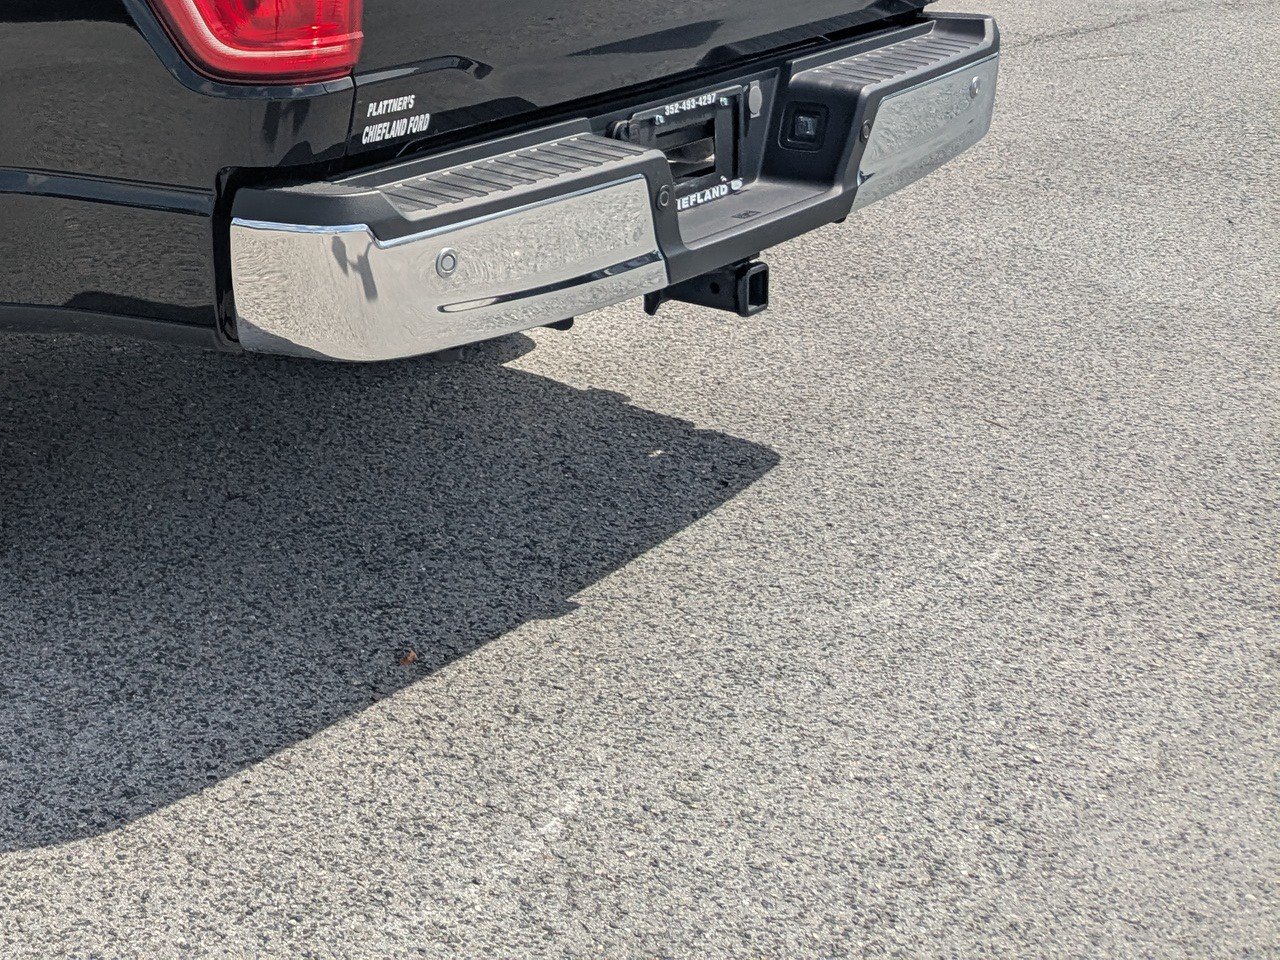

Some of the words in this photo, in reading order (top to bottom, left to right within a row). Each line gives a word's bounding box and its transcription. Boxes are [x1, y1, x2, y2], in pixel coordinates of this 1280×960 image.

[366, 95, 416, 118] PLATTNER'S
[361, 118, 408, 145] CHIEFLAND
[406, 113, 431, 135] FORD
